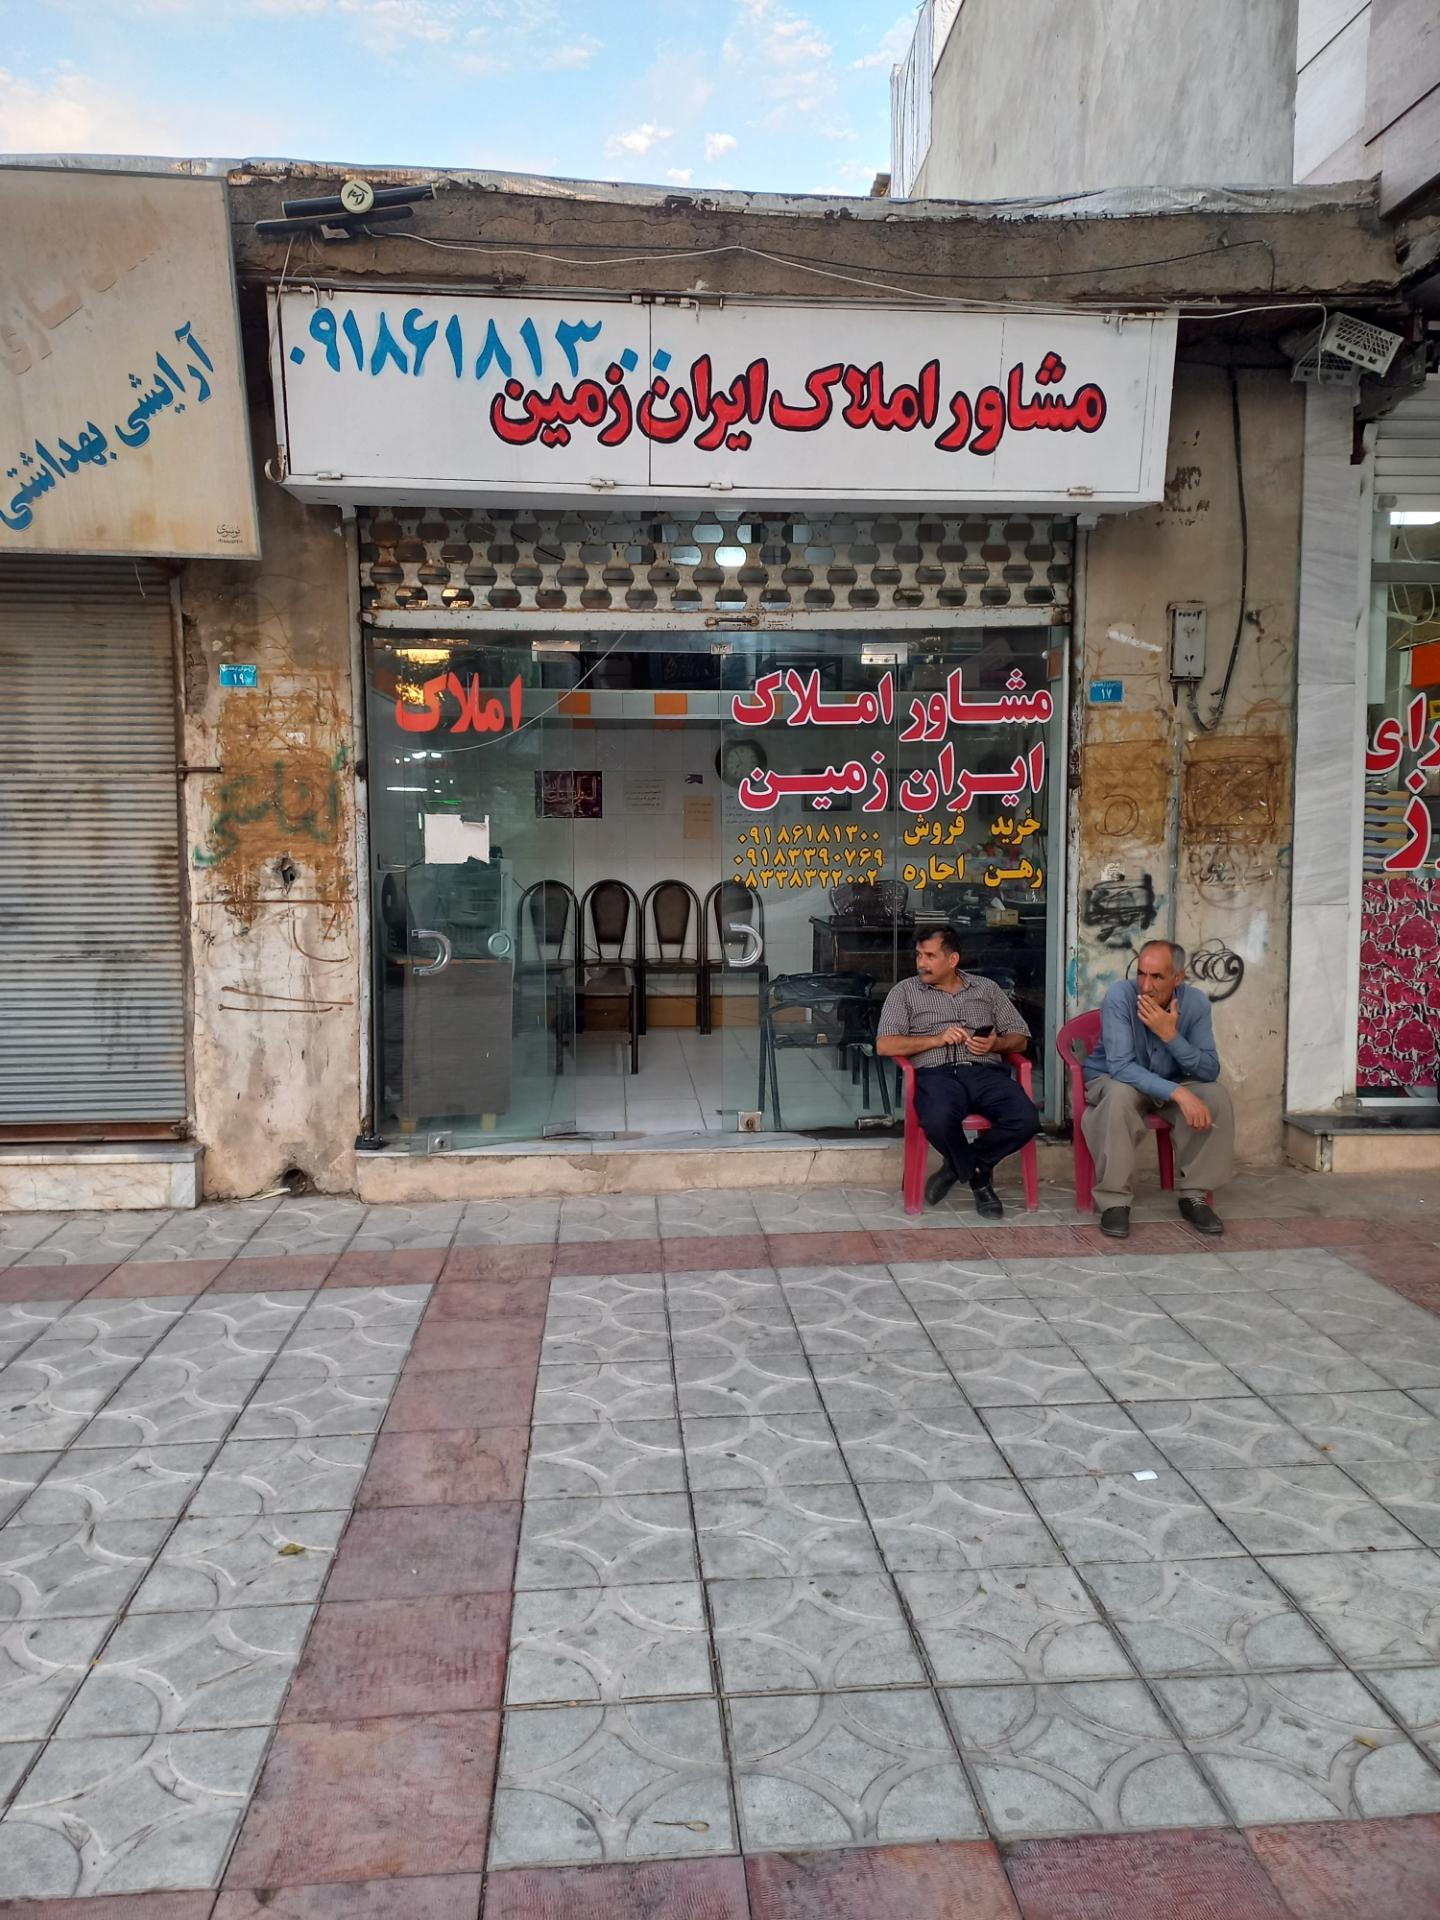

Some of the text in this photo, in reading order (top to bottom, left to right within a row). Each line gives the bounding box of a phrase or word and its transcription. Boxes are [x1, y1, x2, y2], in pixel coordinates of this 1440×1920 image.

[288, 306, 672, 381] ۰۹۱۸۶۱۸۱۳۰۰
[0, 320, 214, 531] آرایشی بهداشتی
[490, 350, 1106, 455] مشاور املاک ایران زمین
[232, 672, 245, 685] ۱۹
[394, 671, 524, 734] املاک
[731, 668, 894, 726] املاک
[899, 667, 1053, 742] مشاور
[1101, 687, 1112, 700] ۱۷
[738, 750, 889, 812] زمین
[900, 741, 1045, 812] ایران
[733, 846, 885, 867] ۰۹۱۸۳۳۹۰۷۶۹
[737, 824, 881, 846] ۰۹۱۸۶۱۸۱۳۰۰
[902, 808, 1042, 847] خرید فروش
[732, 867, 879, 889] ۰۸۳۳۸۳۲۲۰۰۲
[902, 853, 1045, 890] رهن اجاره
